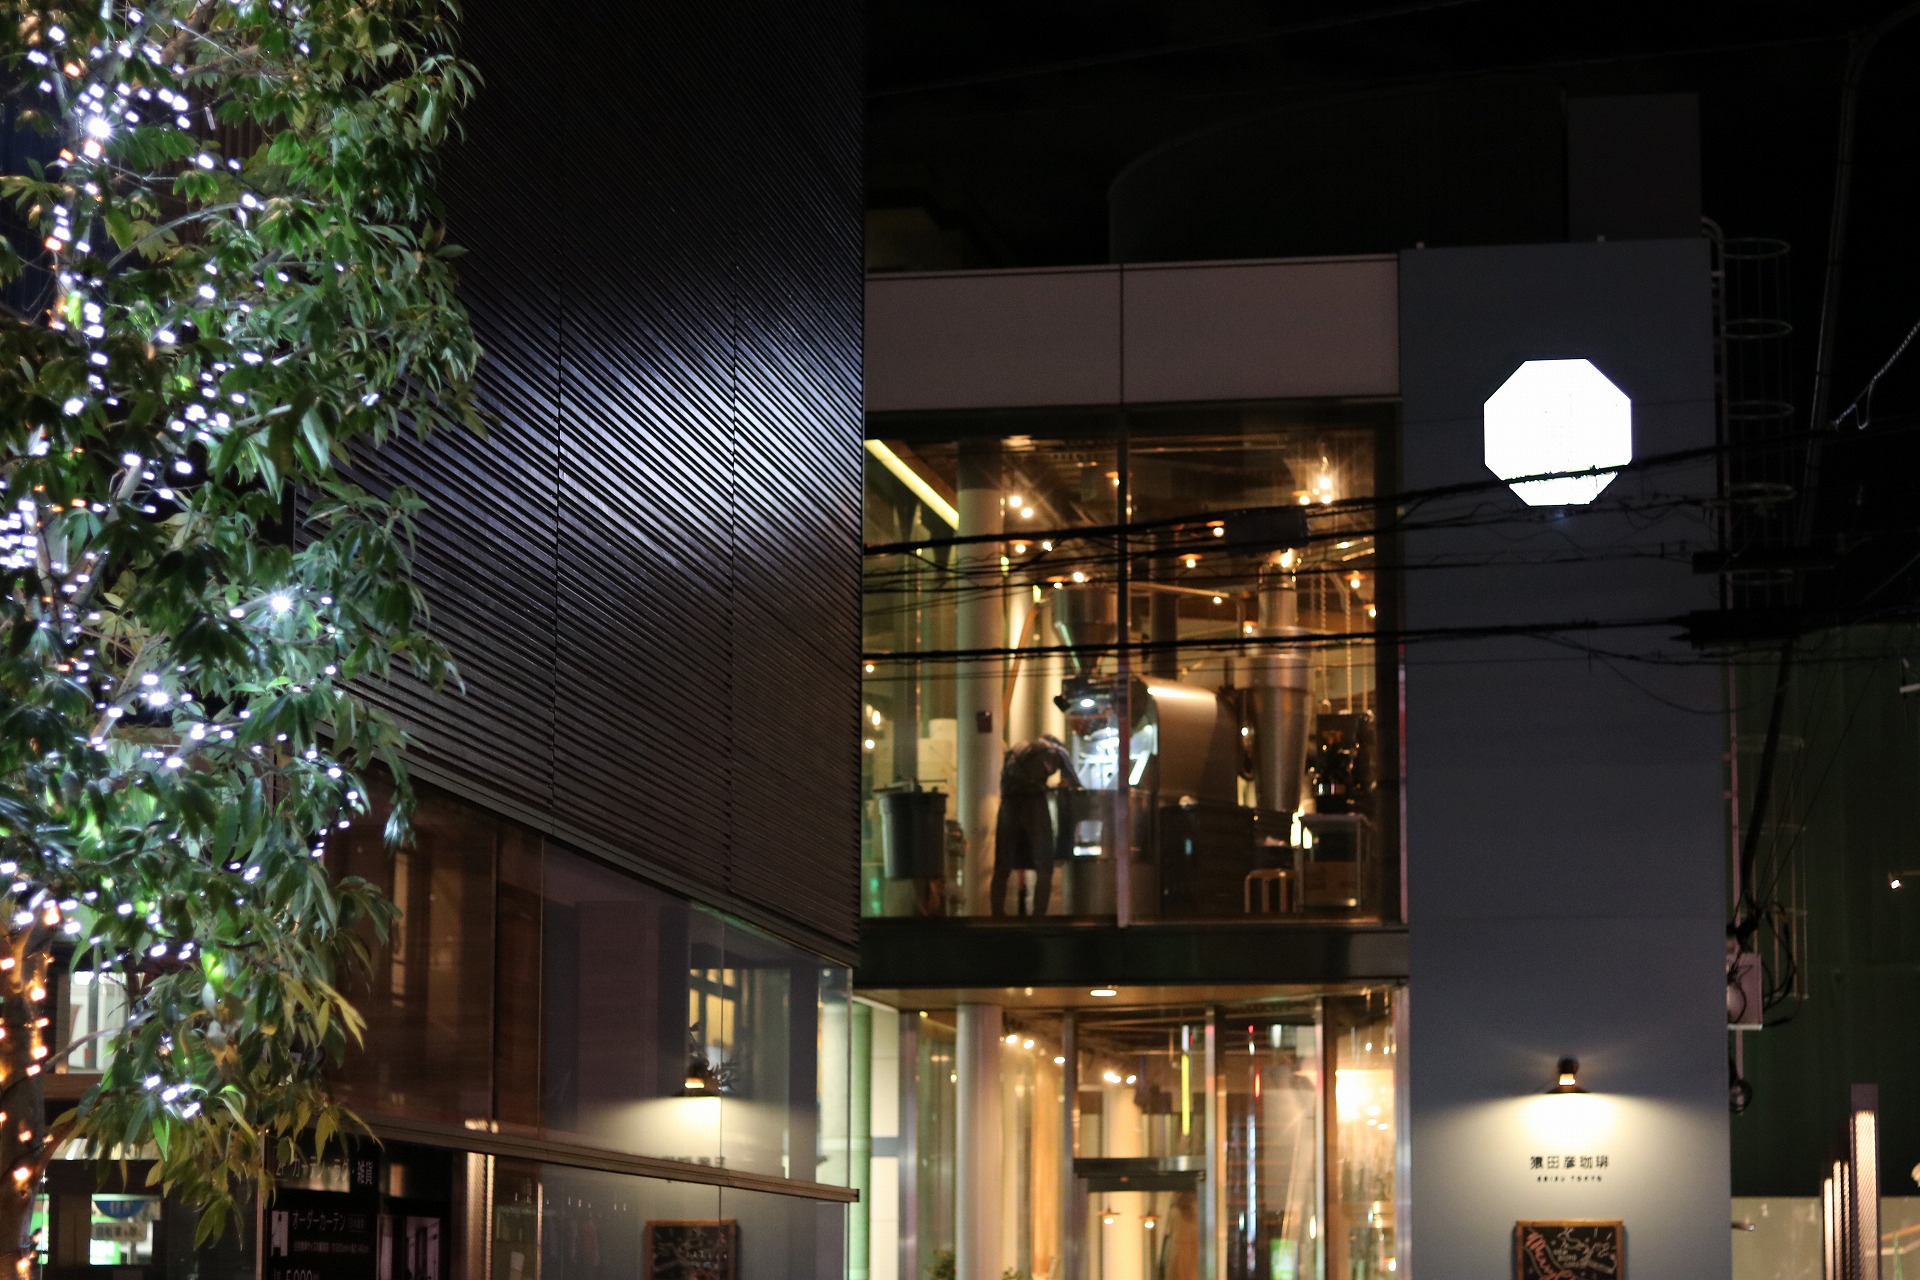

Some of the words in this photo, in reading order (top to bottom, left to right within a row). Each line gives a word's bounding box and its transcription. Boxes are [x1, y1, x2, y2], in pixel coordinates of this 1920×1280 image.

[1530, 1155, 1609, 1170] 猿田彦珈琲
[1570, 1175, 1602, 1183] TOKYO
[291, 1209, 346, 1233] オーダーカーテン
